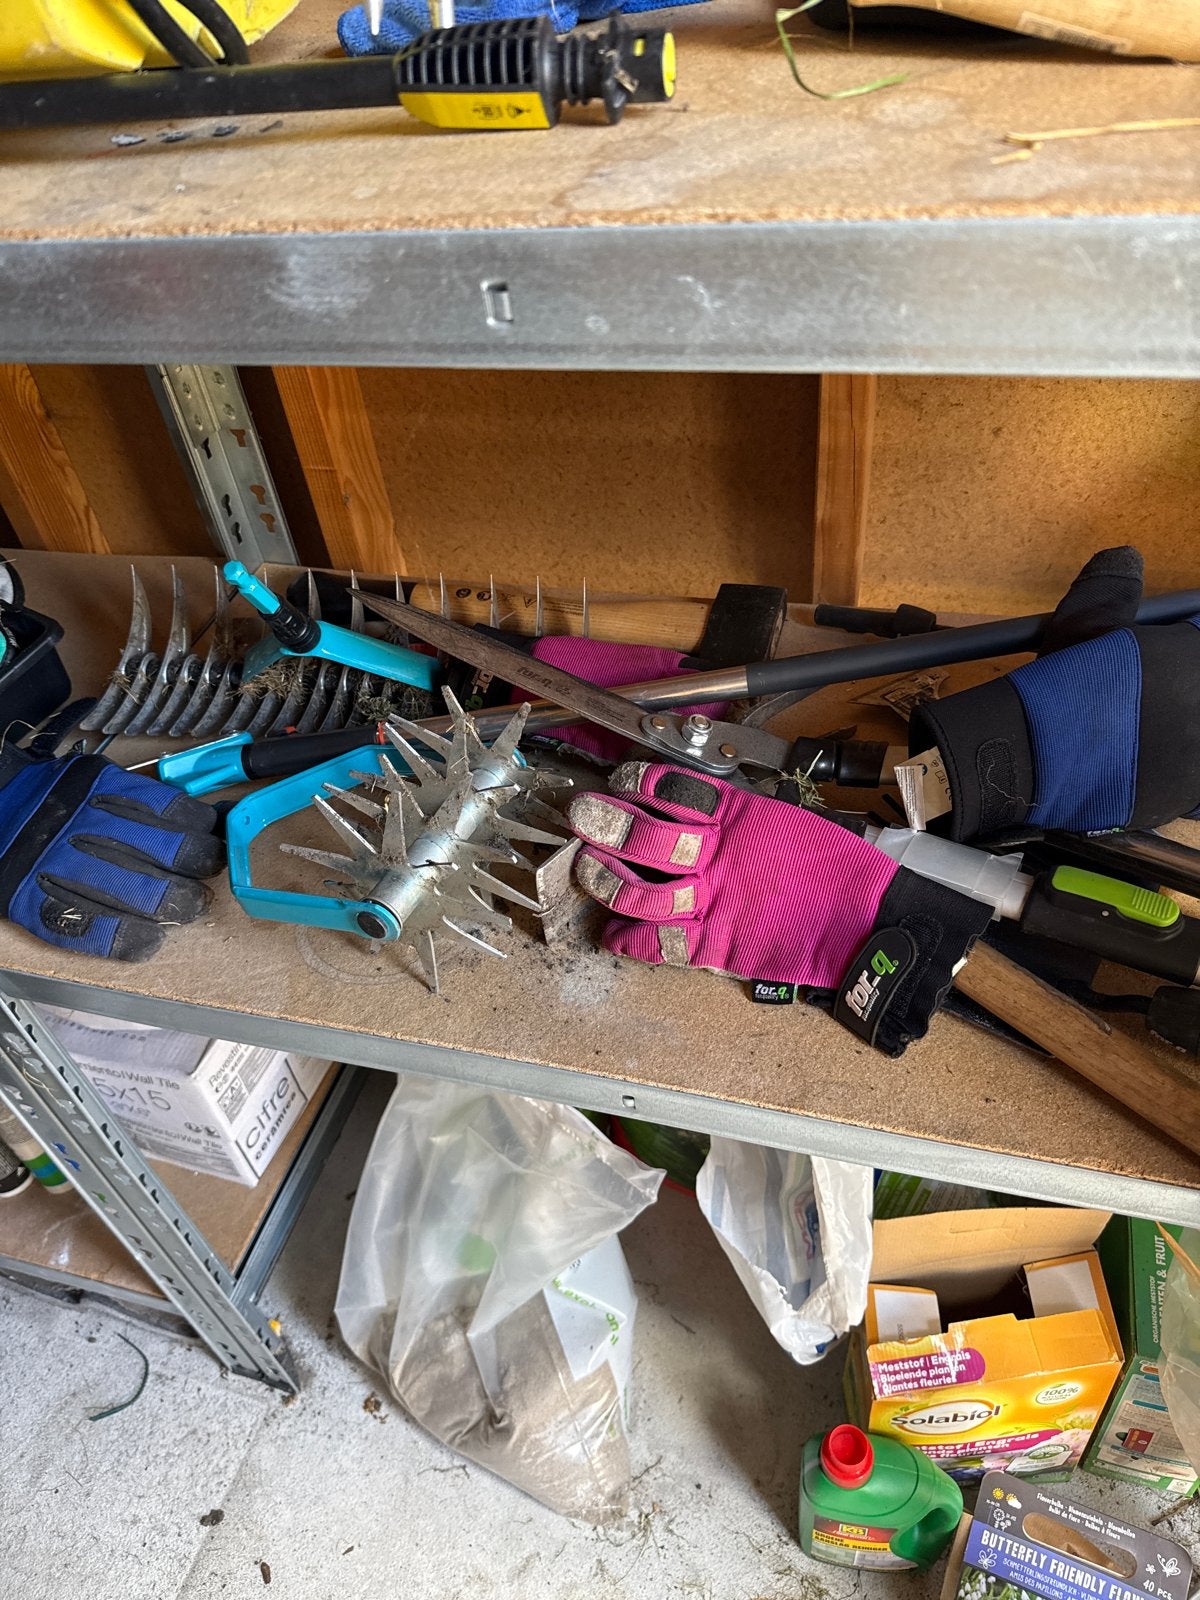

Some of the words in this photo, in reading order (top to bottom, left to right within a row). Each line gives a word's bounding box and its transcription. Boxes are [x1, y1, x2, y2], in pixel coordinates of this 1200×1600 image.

[1154, 1234, 1167, 1267] FRUIT
[877, 1356, 926, 1375] Meststof
[879, 1366, 928, 1384] Bloeiende
[1044, 1386, 1080, 1397] 100%
[890, 1404, 1002, 1426] Solabiol
[974, 1432, 1040, 1448] Engrais
[980, 1529, 1048, 1570] BUTTERFLY
[1049, 1558, 1107, 1596] FRIENDLY
[1009, 1570, 1024, 1583] AMIS
[1024, 1576, 1036, 1588] DES
[1034, 1580, 1064, 1600] PAPILLONS
[1142, 1579, 1155, 1593] 40
